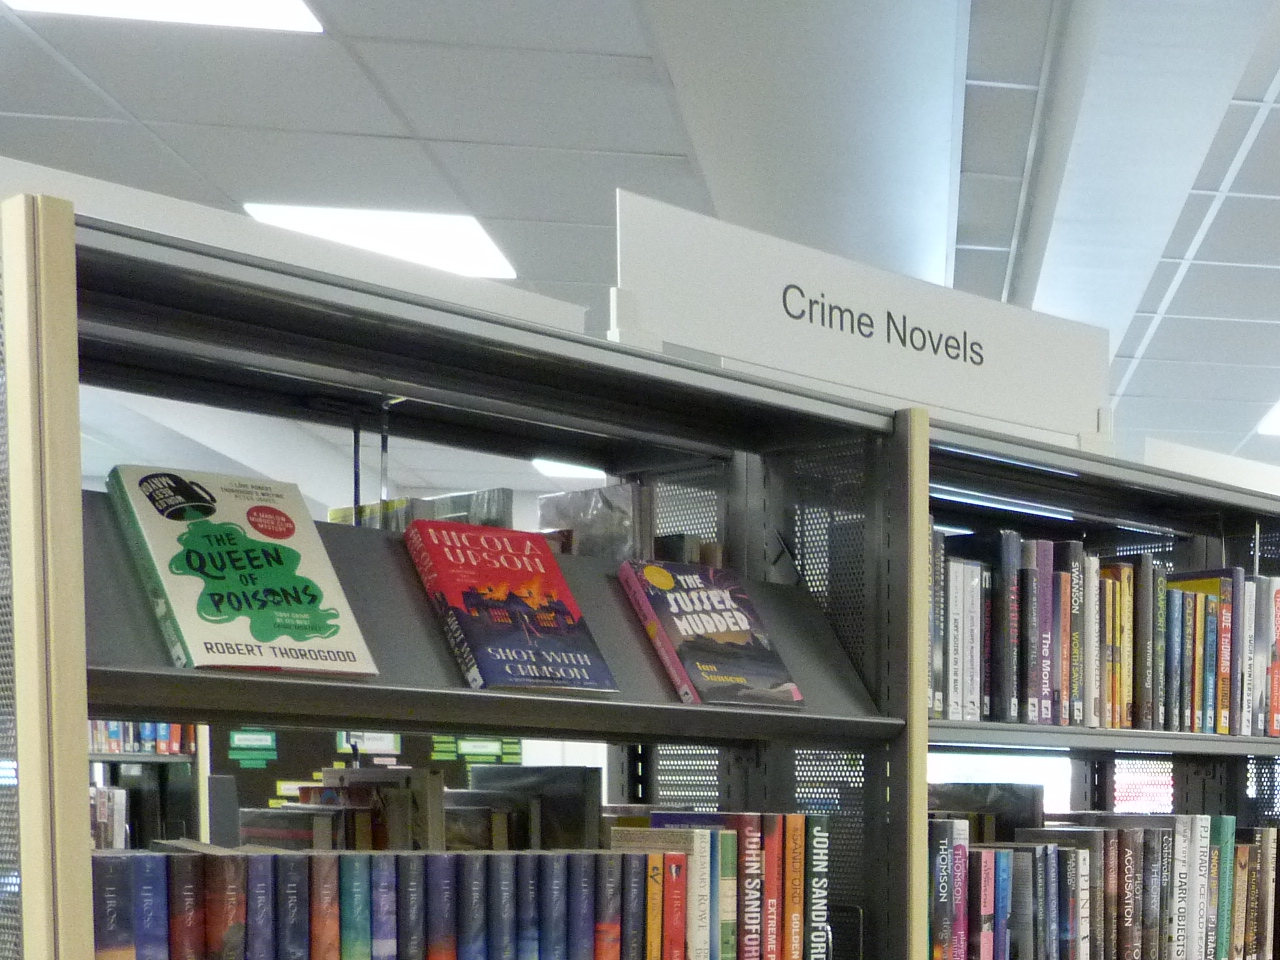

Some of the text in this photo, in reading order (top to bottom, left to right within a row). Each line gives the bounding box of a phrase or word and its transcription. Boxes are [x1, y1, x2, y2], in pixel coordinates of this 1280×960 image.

[782, 284, 985, 366] Crime Novels
[203, 533, 238, 547] THE
[429, 529, 543, 557] NICOLA
[185, 547, 283, 580] QUEEN
[444, 548, 545, 573] UPSON
[240, 574, 258, 586] OF
[676, 574, 705, 588] THE
[208, 585, 317, 612] POISONS
[667, 589, 738, 613] SUSSEX
[672, 610, 750, 636] MURDER
[204, 642, 356, 662] ROBERT THOROGOOD
[1221, 609, 1230, 673] JOE THOMAS
[488, 648, 591, 665] SHOT WITH
[696, 662, 718, 672] Ian
[1042, 632, 1050, 695] The Monk
[506, 664, 589, 679] CRIMSON
[1200, 825, 1208, 842] P.J.
[745, 826, 761, 874] JOHN
[812, 826, 829, 872] JOHN
[1199, 845, 1207, 878] TRACY
[791, 833, 802, 904] SANDFORD
[940, 838, 948, 902] THOMSON
[954, 849, 962, 904] THOMSON
[1210, 850, 1218, 878] SNOW
[1124, 849, 1132, 927] ACCUSATION
[768, 899, 776, 951] EXTREME
[939, 917, 951, 939] dog
[1176, 872, 1187, 957] DARK OBJECTS
[791, 913, 800, 960] GOLDEN
